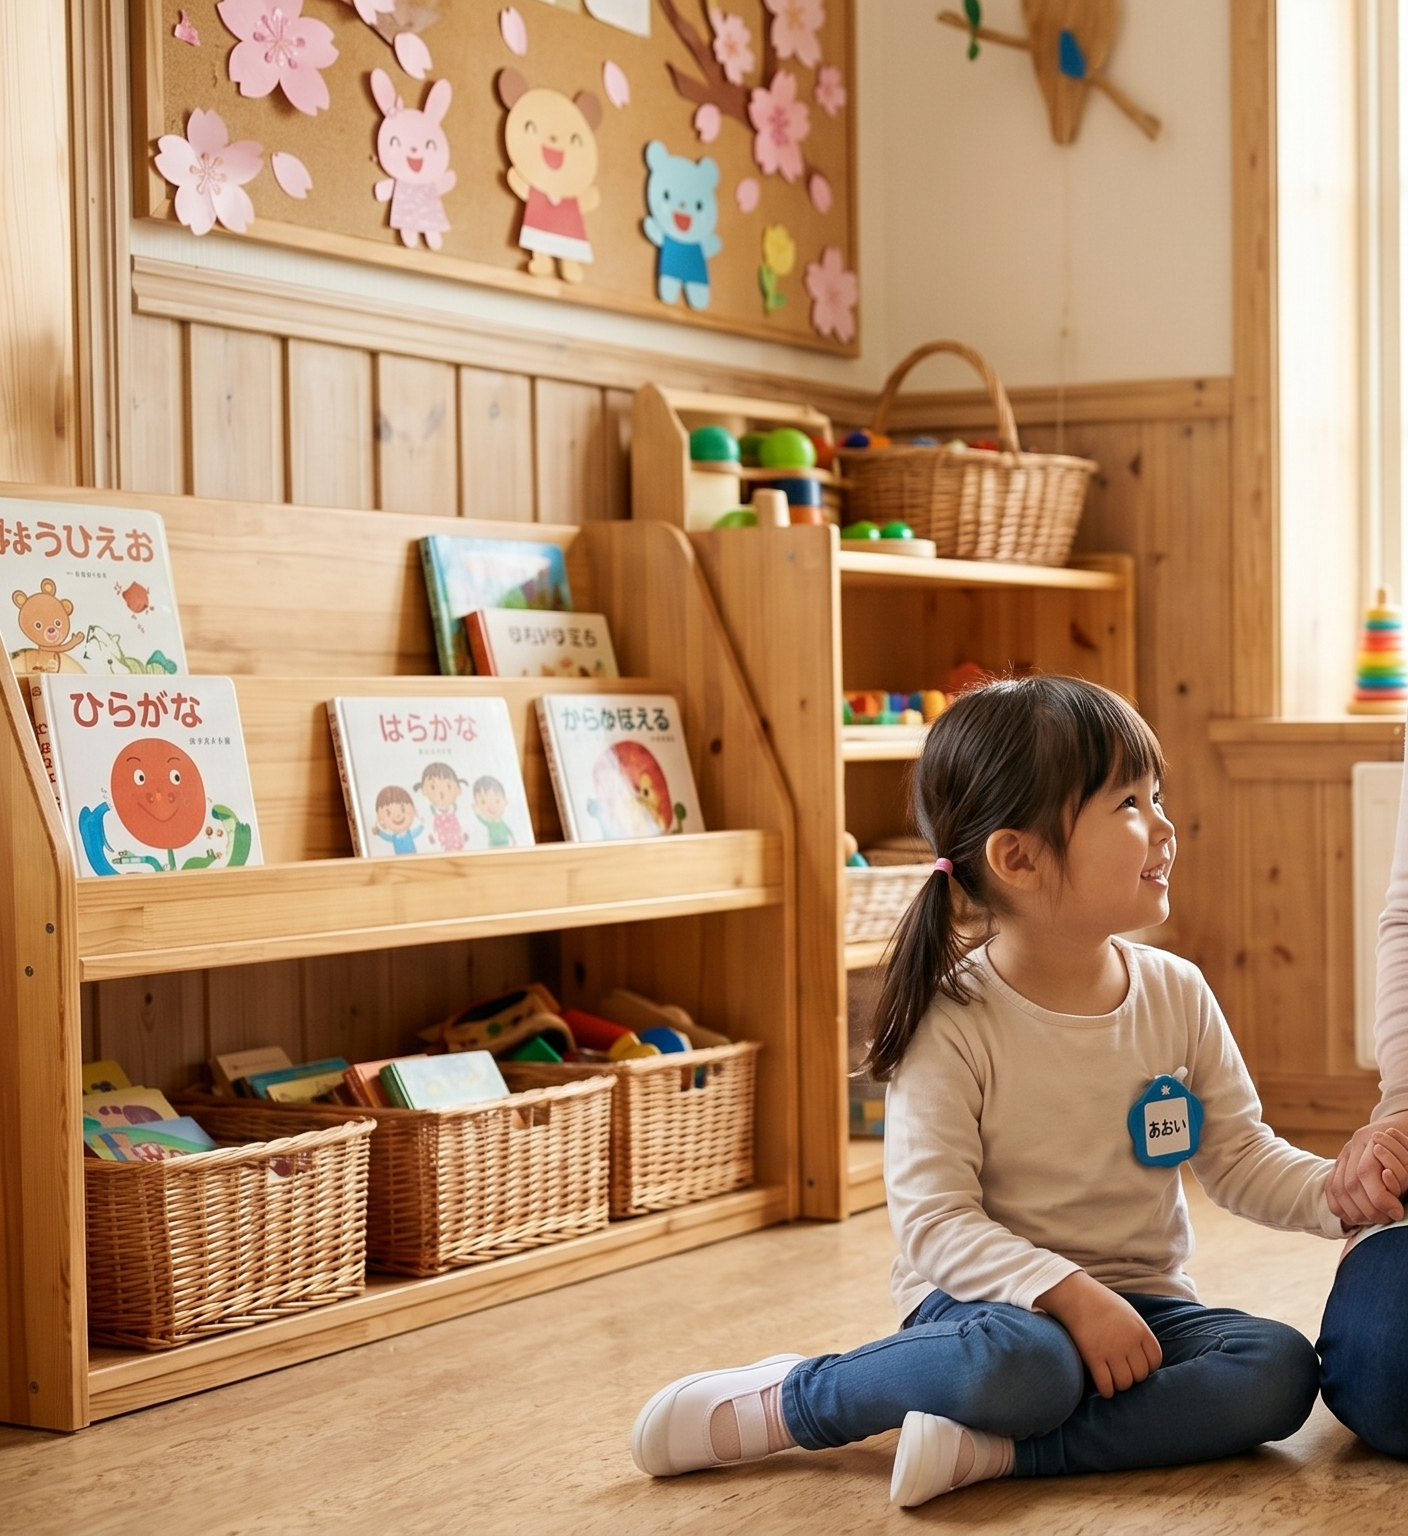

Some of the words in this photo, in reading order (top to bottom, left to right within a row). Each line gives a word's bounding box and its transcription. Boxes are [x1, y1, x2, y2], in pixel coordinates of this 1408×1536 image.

[69, 689, 203, 729] ひらがな
[378, 713, 478, 743] はらかな
[1148, 1118, 1187, 1139] あおい
